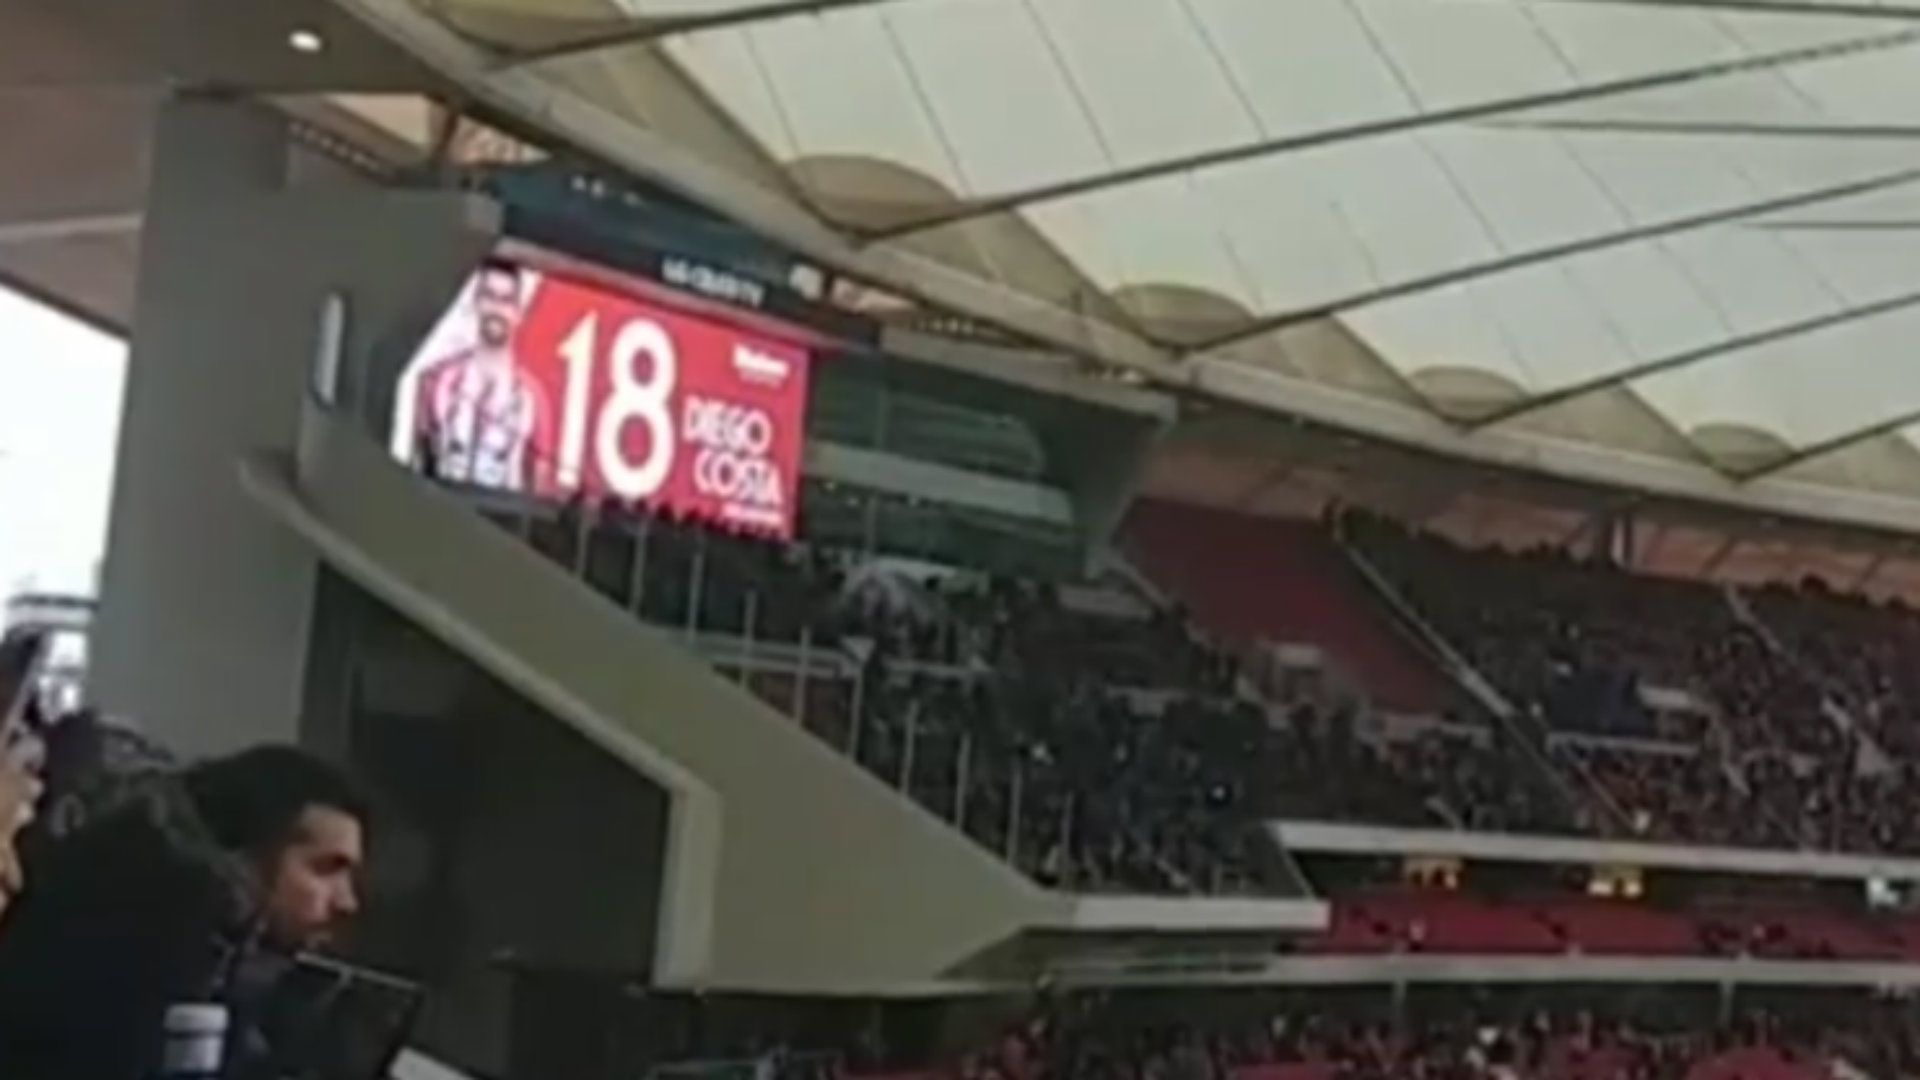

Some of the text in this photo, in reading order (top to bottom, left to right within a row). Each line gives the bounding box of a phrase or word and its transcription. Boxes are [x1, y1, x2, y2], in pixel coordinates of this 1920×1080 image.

[556, 312, 677, 498] 18
[683, 395, 773, 455] DIEGO
[694, 448, 783, 504] COSTA
